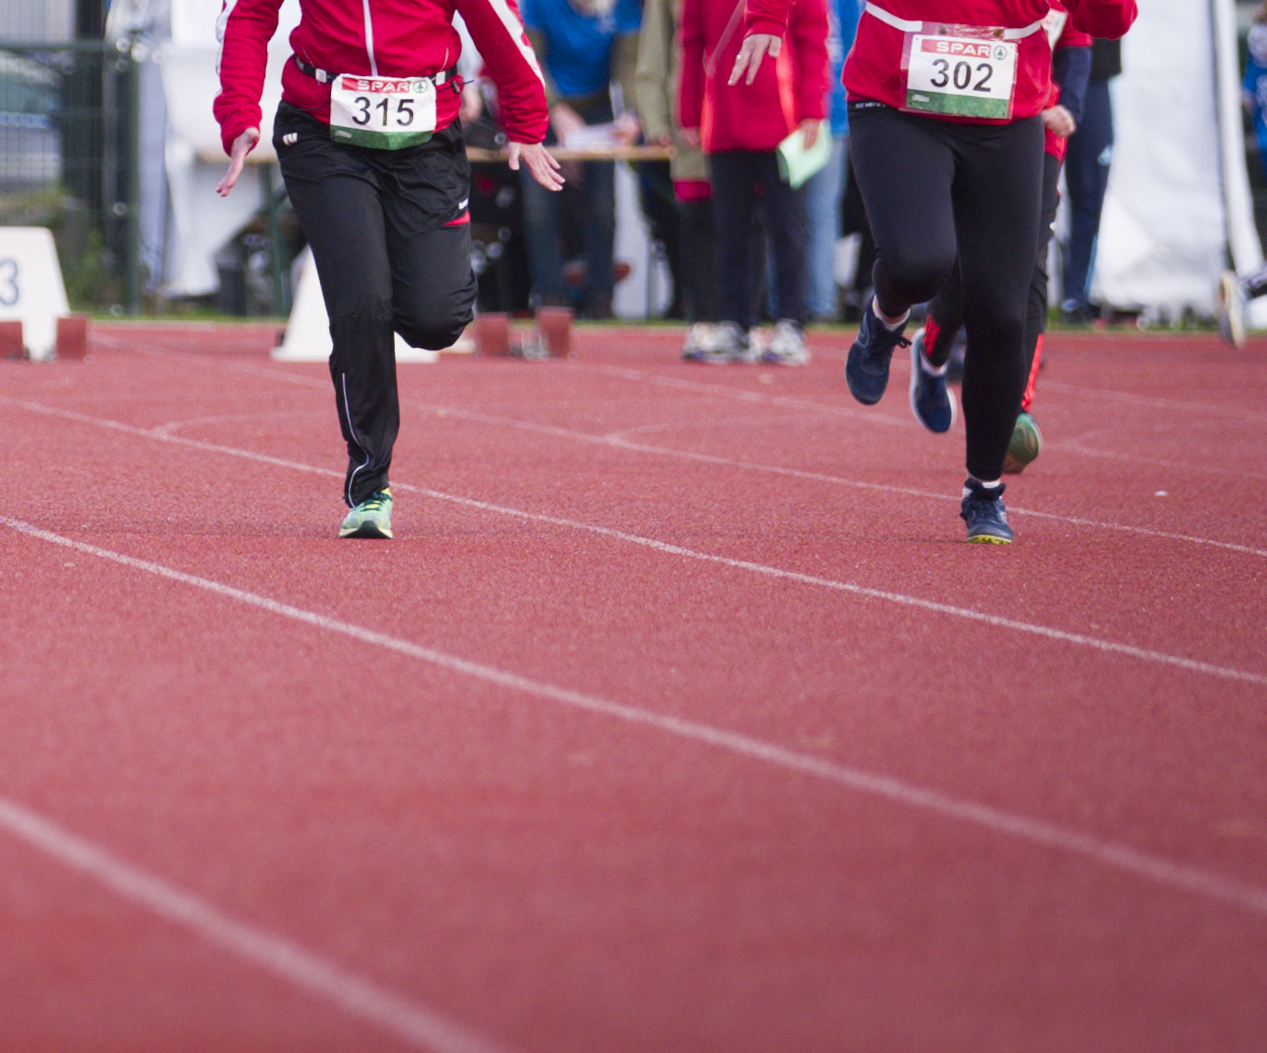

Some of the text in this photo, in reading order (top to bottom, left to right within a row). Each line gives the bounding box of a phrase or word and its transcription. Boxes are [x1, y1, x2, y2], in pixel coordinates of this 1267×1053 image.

[936, 41, 990, 57] SPAR
[356, 79, 410, 93] SPAR
[929, 58, 994, 93] 302
[351, 96, 415, 126] 315
